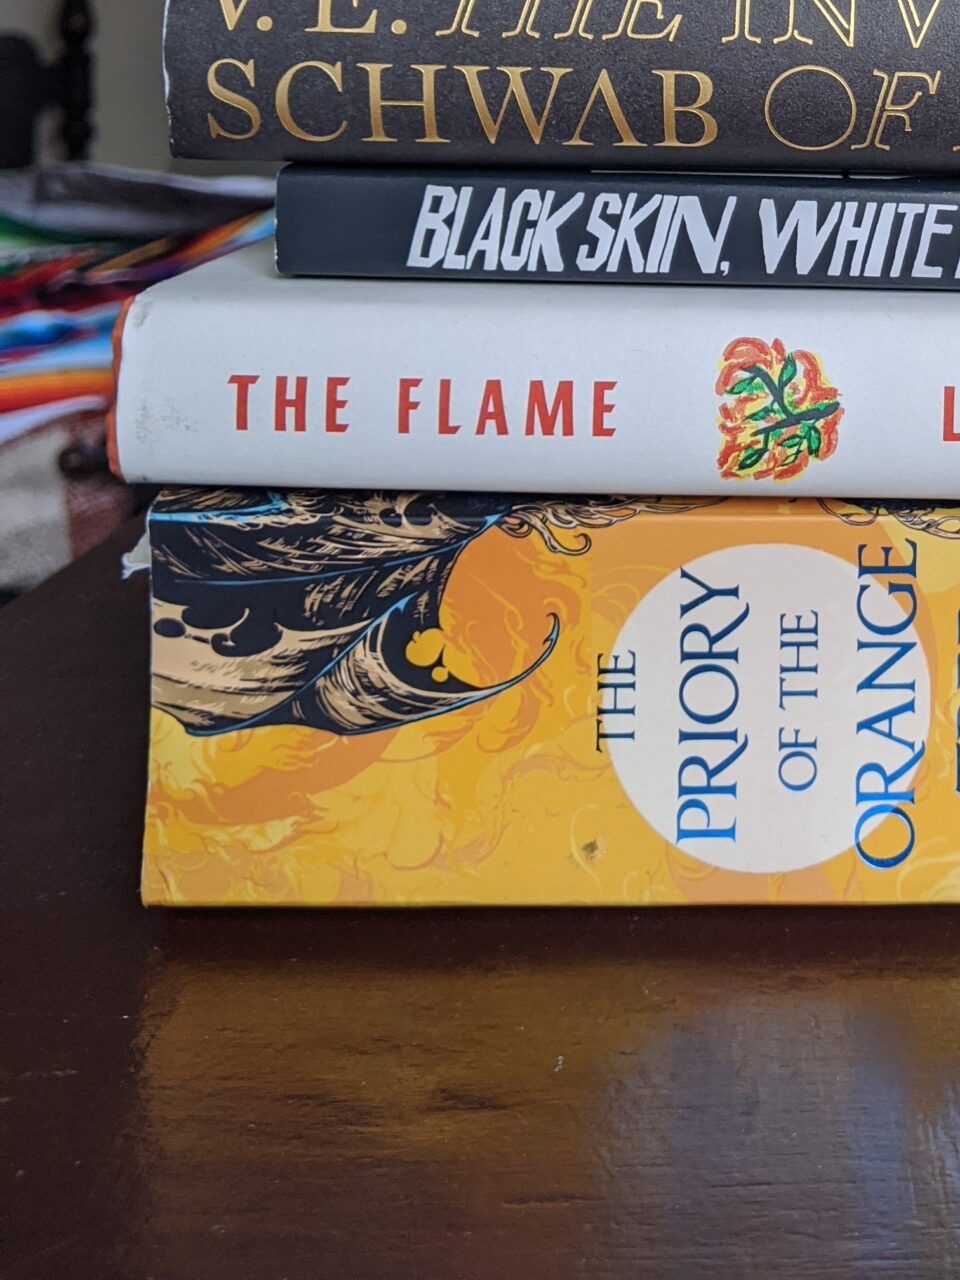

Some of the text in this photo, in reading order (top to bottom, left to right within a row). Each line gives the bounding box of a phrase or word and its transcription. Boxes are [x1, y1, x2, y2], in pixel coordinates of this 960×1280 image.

[206, 58, 718, 148] SCHWAB
[764, 64, 942, 152] OF
[406, 184, 585, 273] BLACK
[575, 192, 737, 277] SKIN,
[758, 198, 959, 279] WHITE
[227, 374, 618, 437] THE FLAME
[595, 648, 636, 754] THE
[675, 566, 750, 845] PRIORY
[777, 608, 820, 792] OF THE
[854, 537, 926, 869] ORANGE
